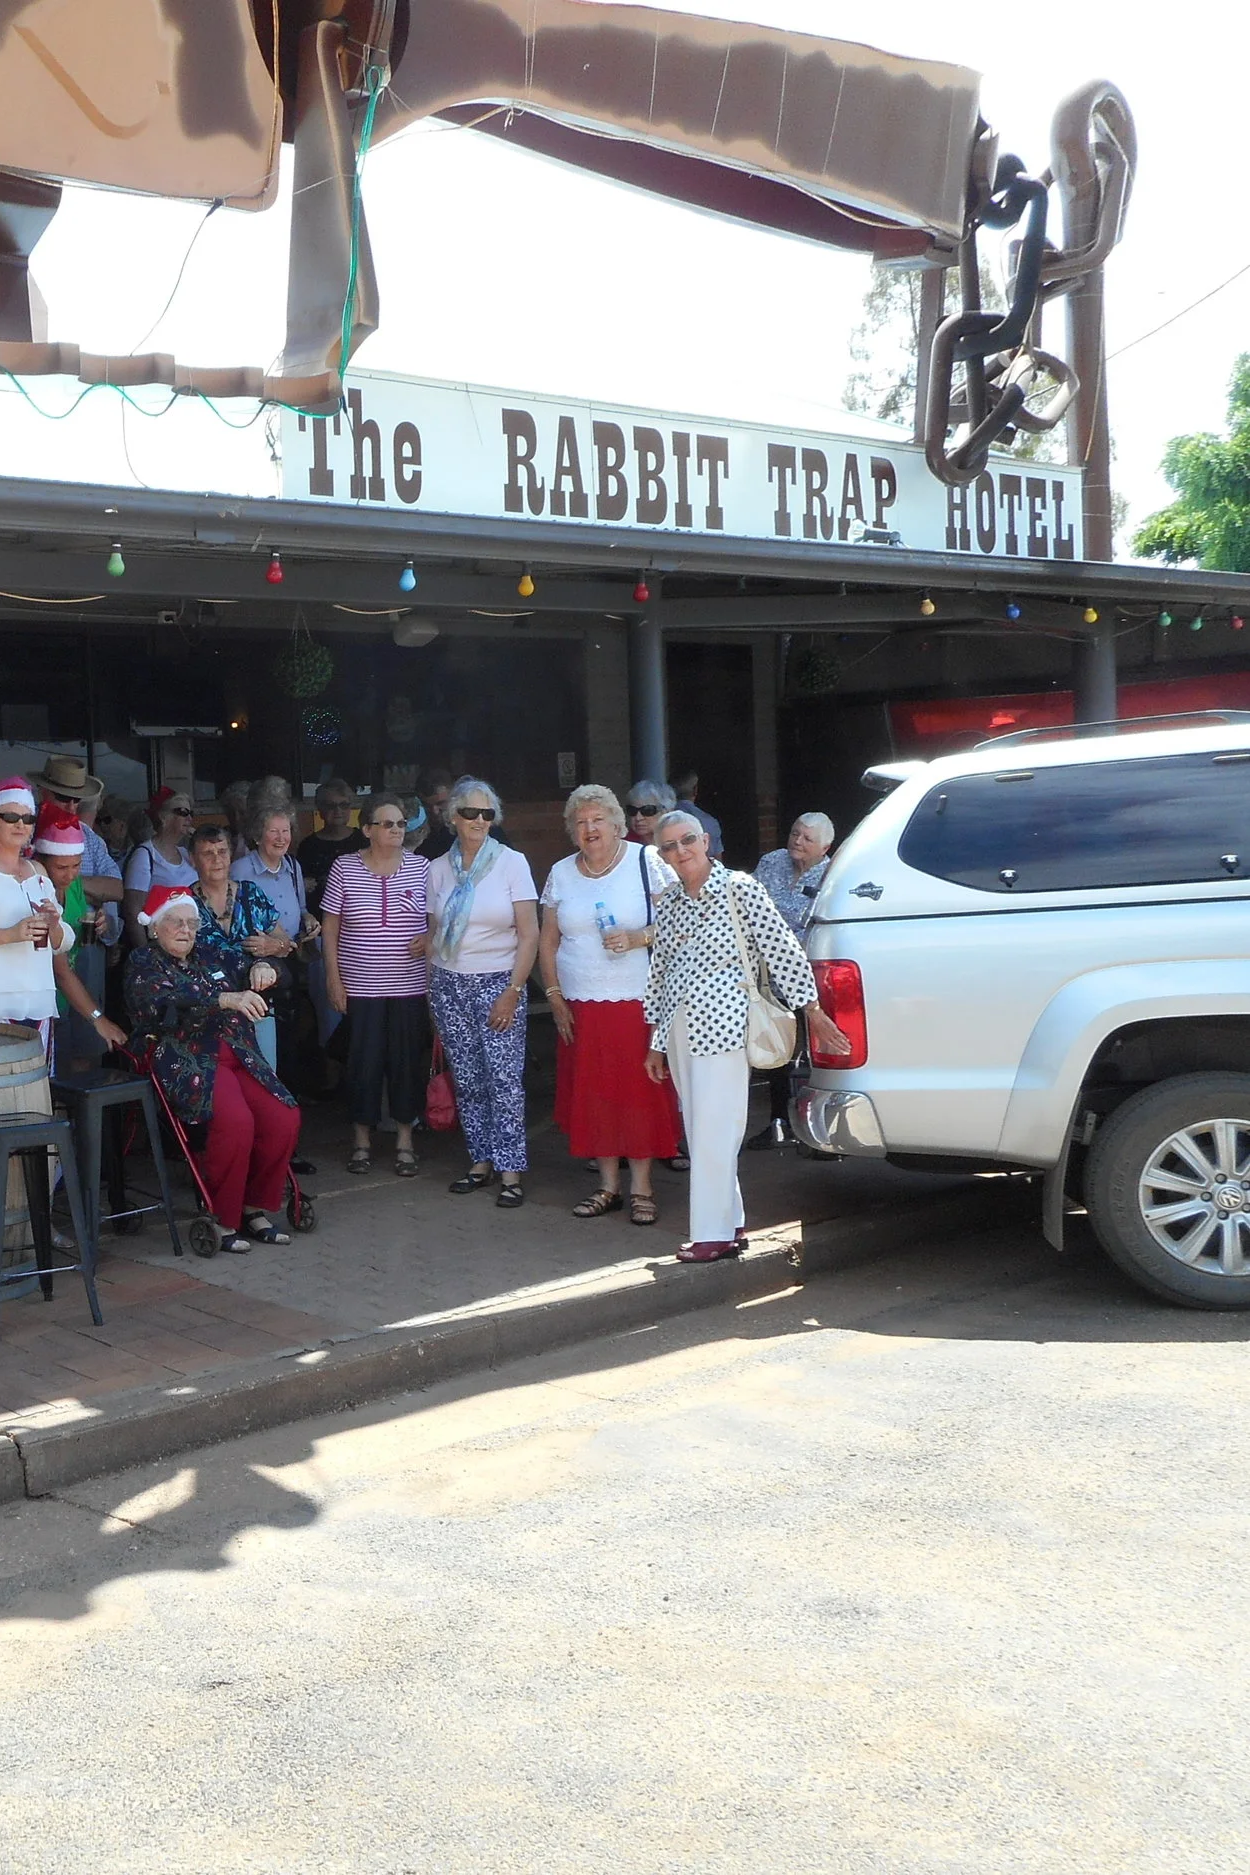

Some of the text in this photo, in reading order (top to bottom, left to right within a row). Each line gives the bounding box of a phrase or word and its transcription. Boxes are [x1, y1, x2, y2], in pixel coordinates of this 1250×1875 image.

[298, 387, 1075, 560] The RABBIT TRAP HOTEL
